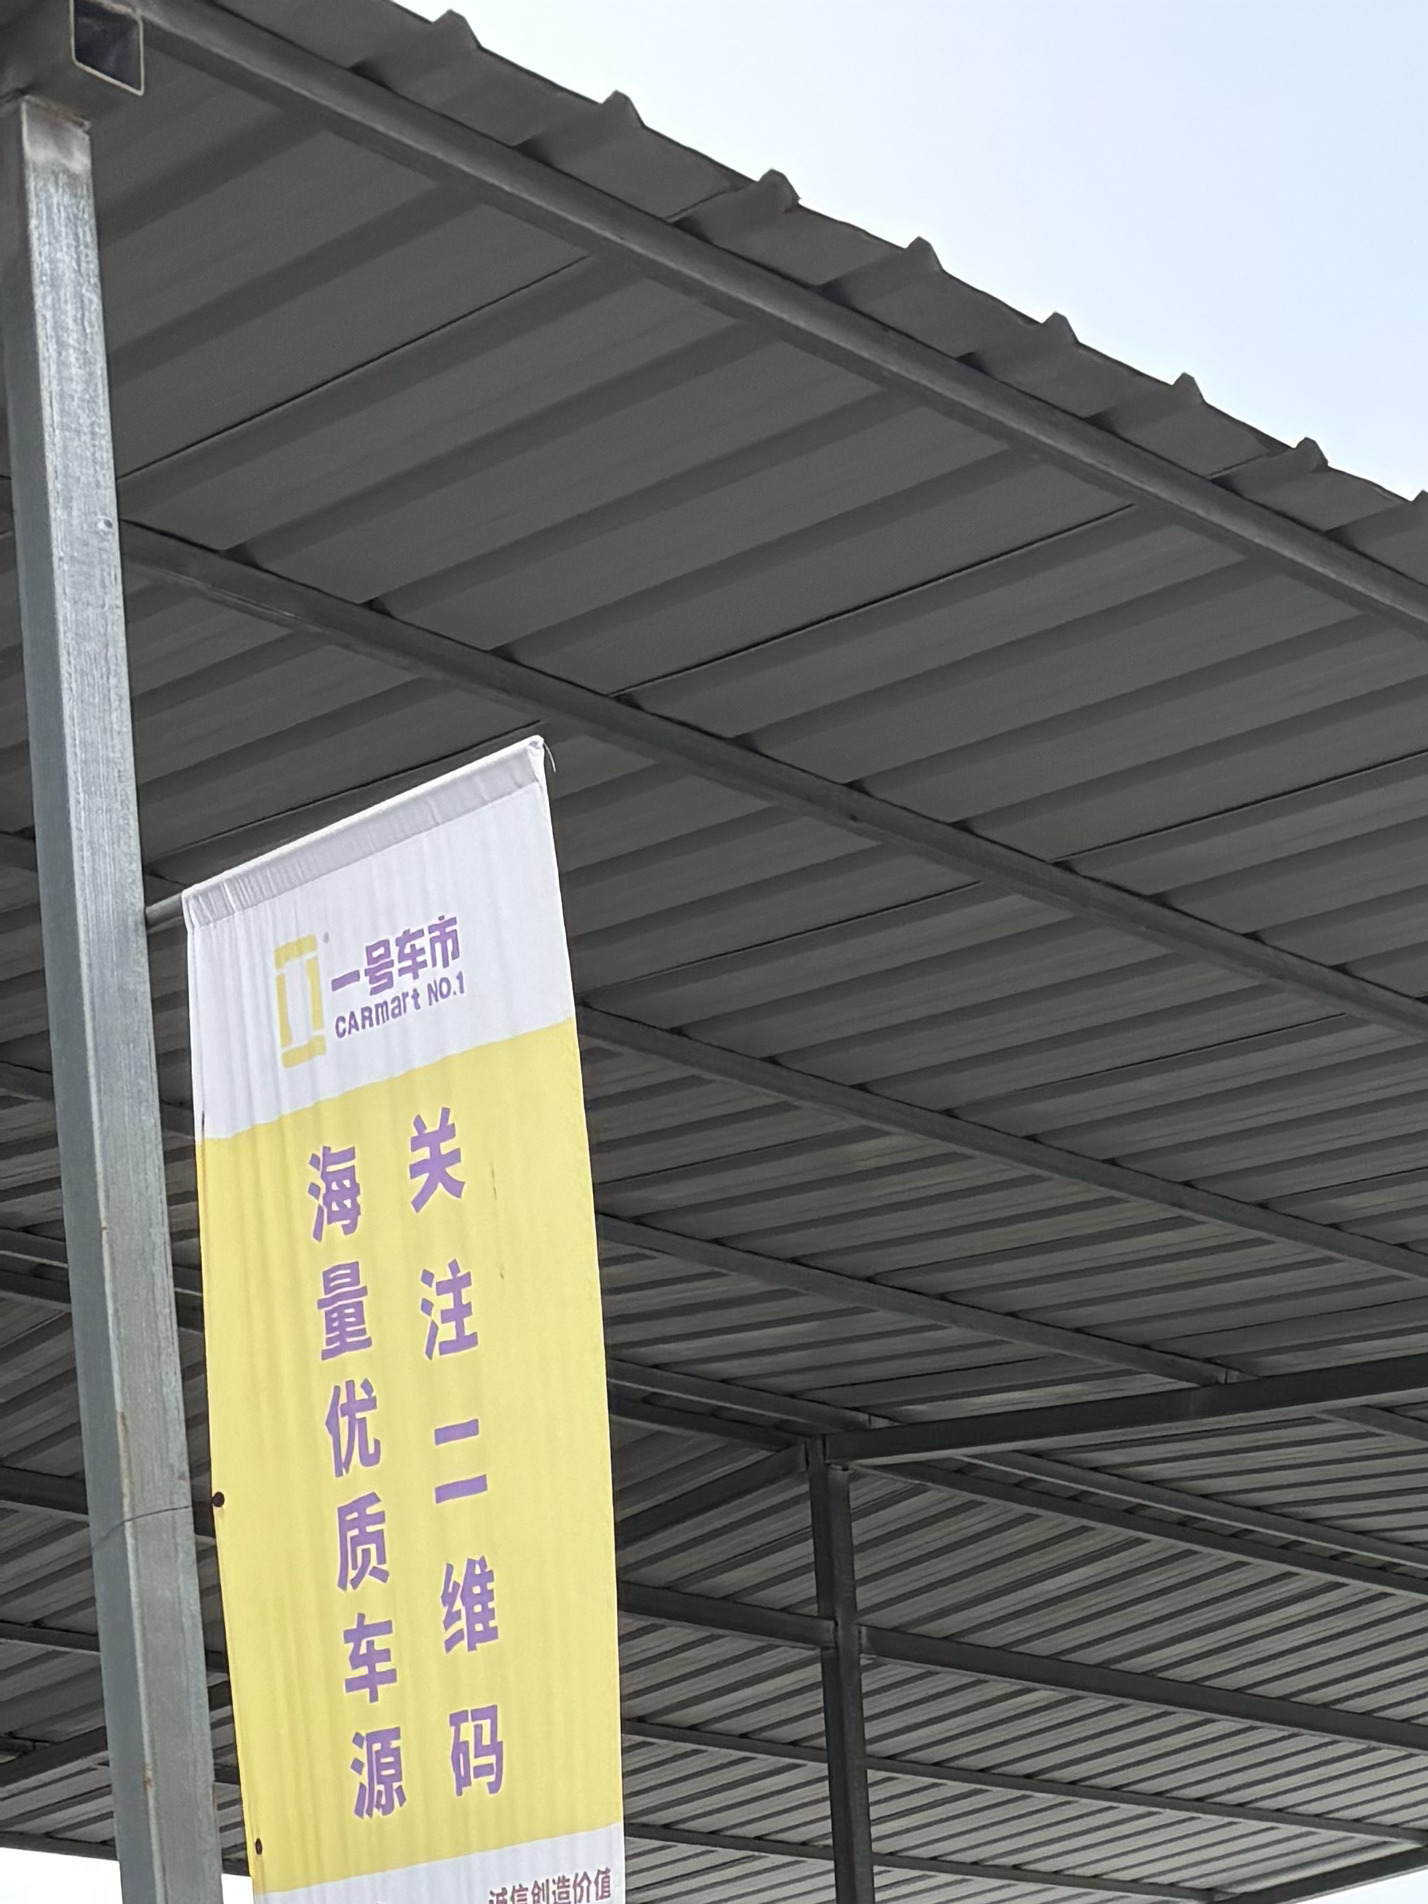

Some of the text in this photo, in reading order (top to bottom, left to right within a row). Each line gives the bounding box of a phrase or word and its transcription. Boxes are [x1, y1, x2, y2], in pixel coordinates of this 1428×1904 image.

[331, 915, 460, 996] 一号车市
[335, 971, 465, 1038] CARmart NO.1
[307, 1145, 407, 1820] 海量优质车源
[409, 1107, 504, 1797] 关注二维码
